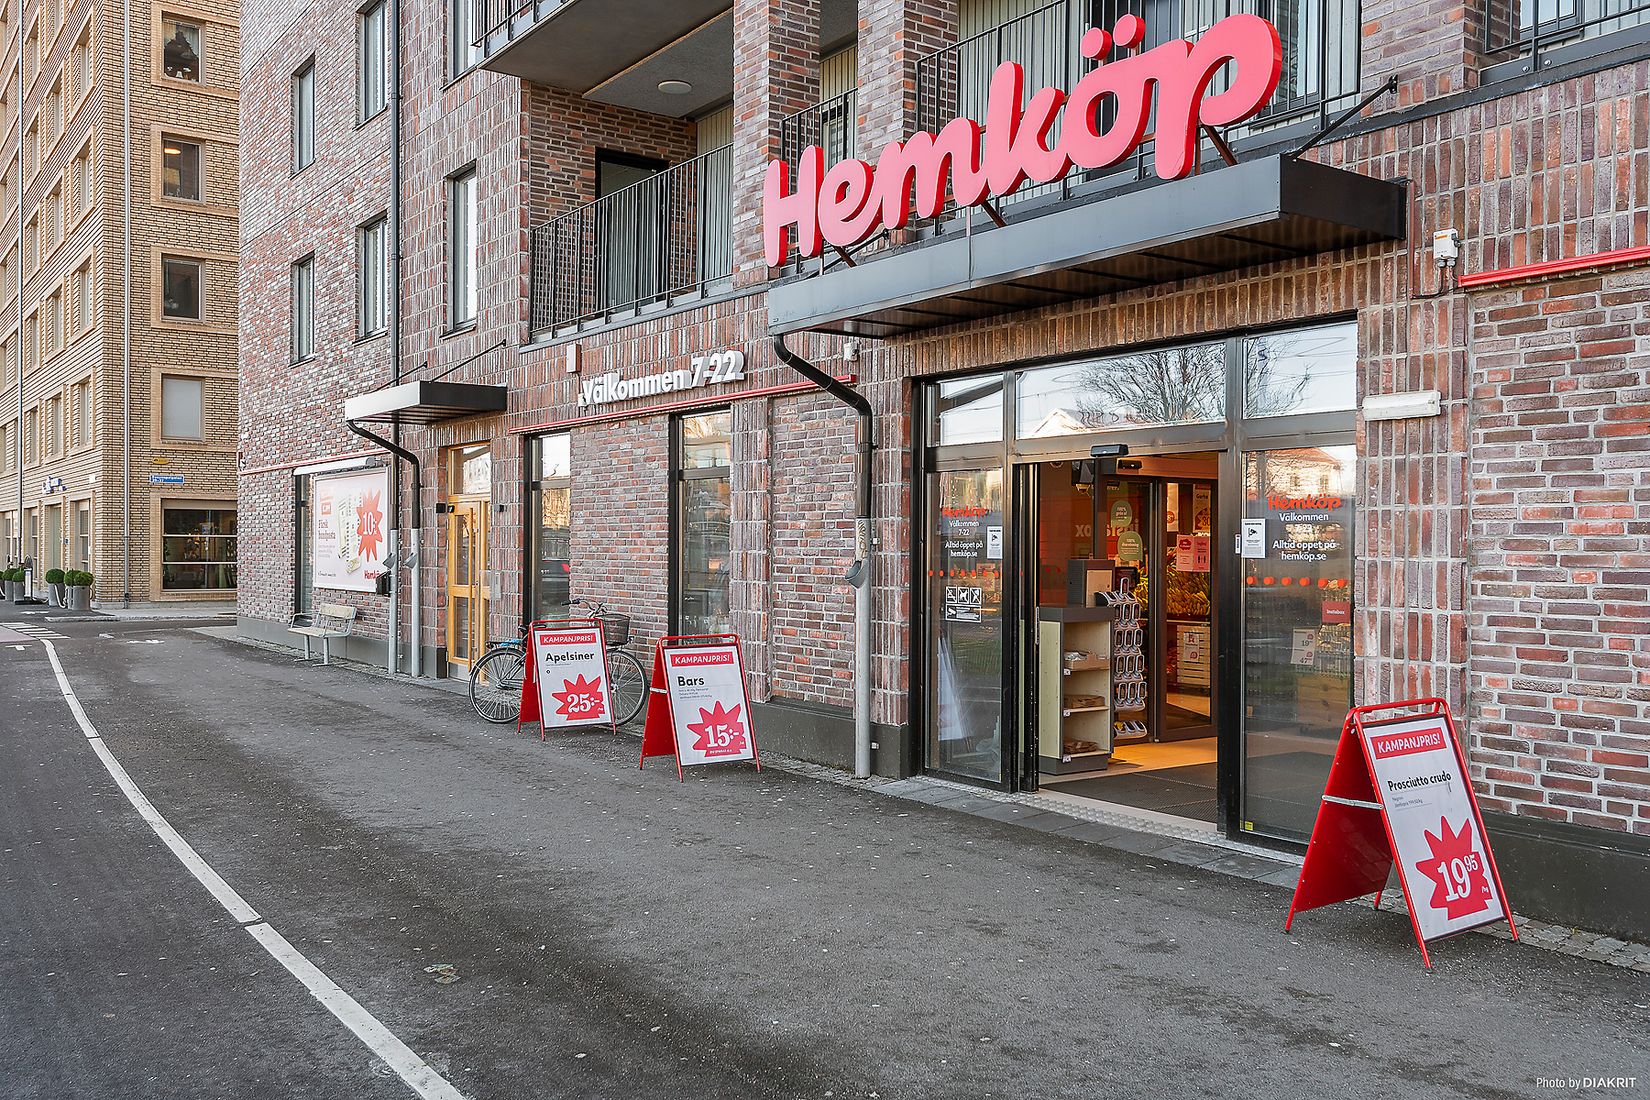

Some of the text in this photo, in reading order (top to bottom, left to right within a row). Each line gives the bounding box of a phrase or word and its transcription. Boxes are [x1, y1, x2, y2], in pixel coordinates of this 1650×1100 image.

[764, 13, 1283, 268] Hemköp
[582, 350, 744, 405] Välkommen 7-22
[1268, 494, 1341, 511] Hemköp
[1279, 512, 1329, 522] Välkommen
[958, 528, 970, 537] 7-22
[1273, 540, 1296, 550] Alltid
[1324, 539, 1337, 551] på
[1281, 552, 1327, 562] hemköp.se
[543, 635, 593, 643] KAMPANJPRIS!
[545, 651, 595, 664] Apelsiner
[675, 655, 730, 664] KAMPANJPRIS!
[677, 676, 705, 687] Bars
[567, 693, 600, 713] 25:-
[704, 724, 739, 747] 15:-
[1377, 732, 1441, 753] KAMPANJPRIS!
[1387, 770, 1452, 791] Prosciutto crudo
